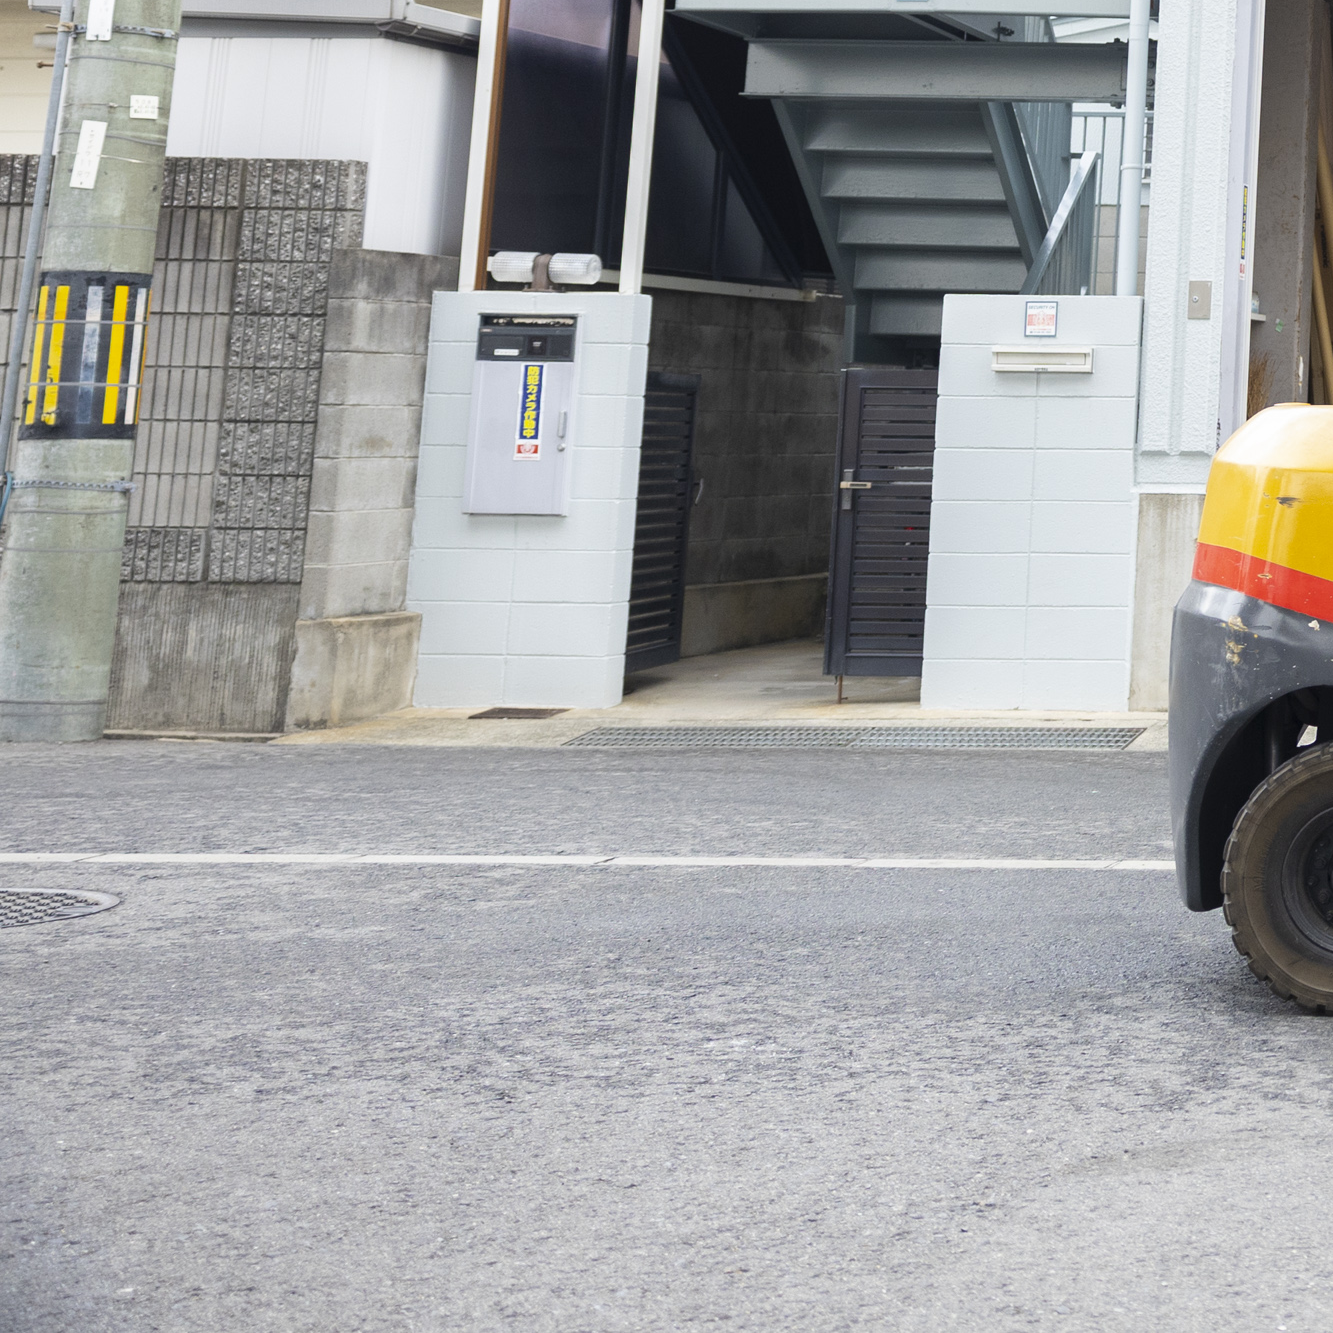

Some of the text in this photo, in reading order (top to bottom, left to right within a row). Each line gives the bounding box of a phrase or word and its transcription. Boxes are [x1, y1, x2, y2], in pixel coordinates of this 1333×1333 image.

[522, 365, 540, 439] 防犯カメラ作動中
